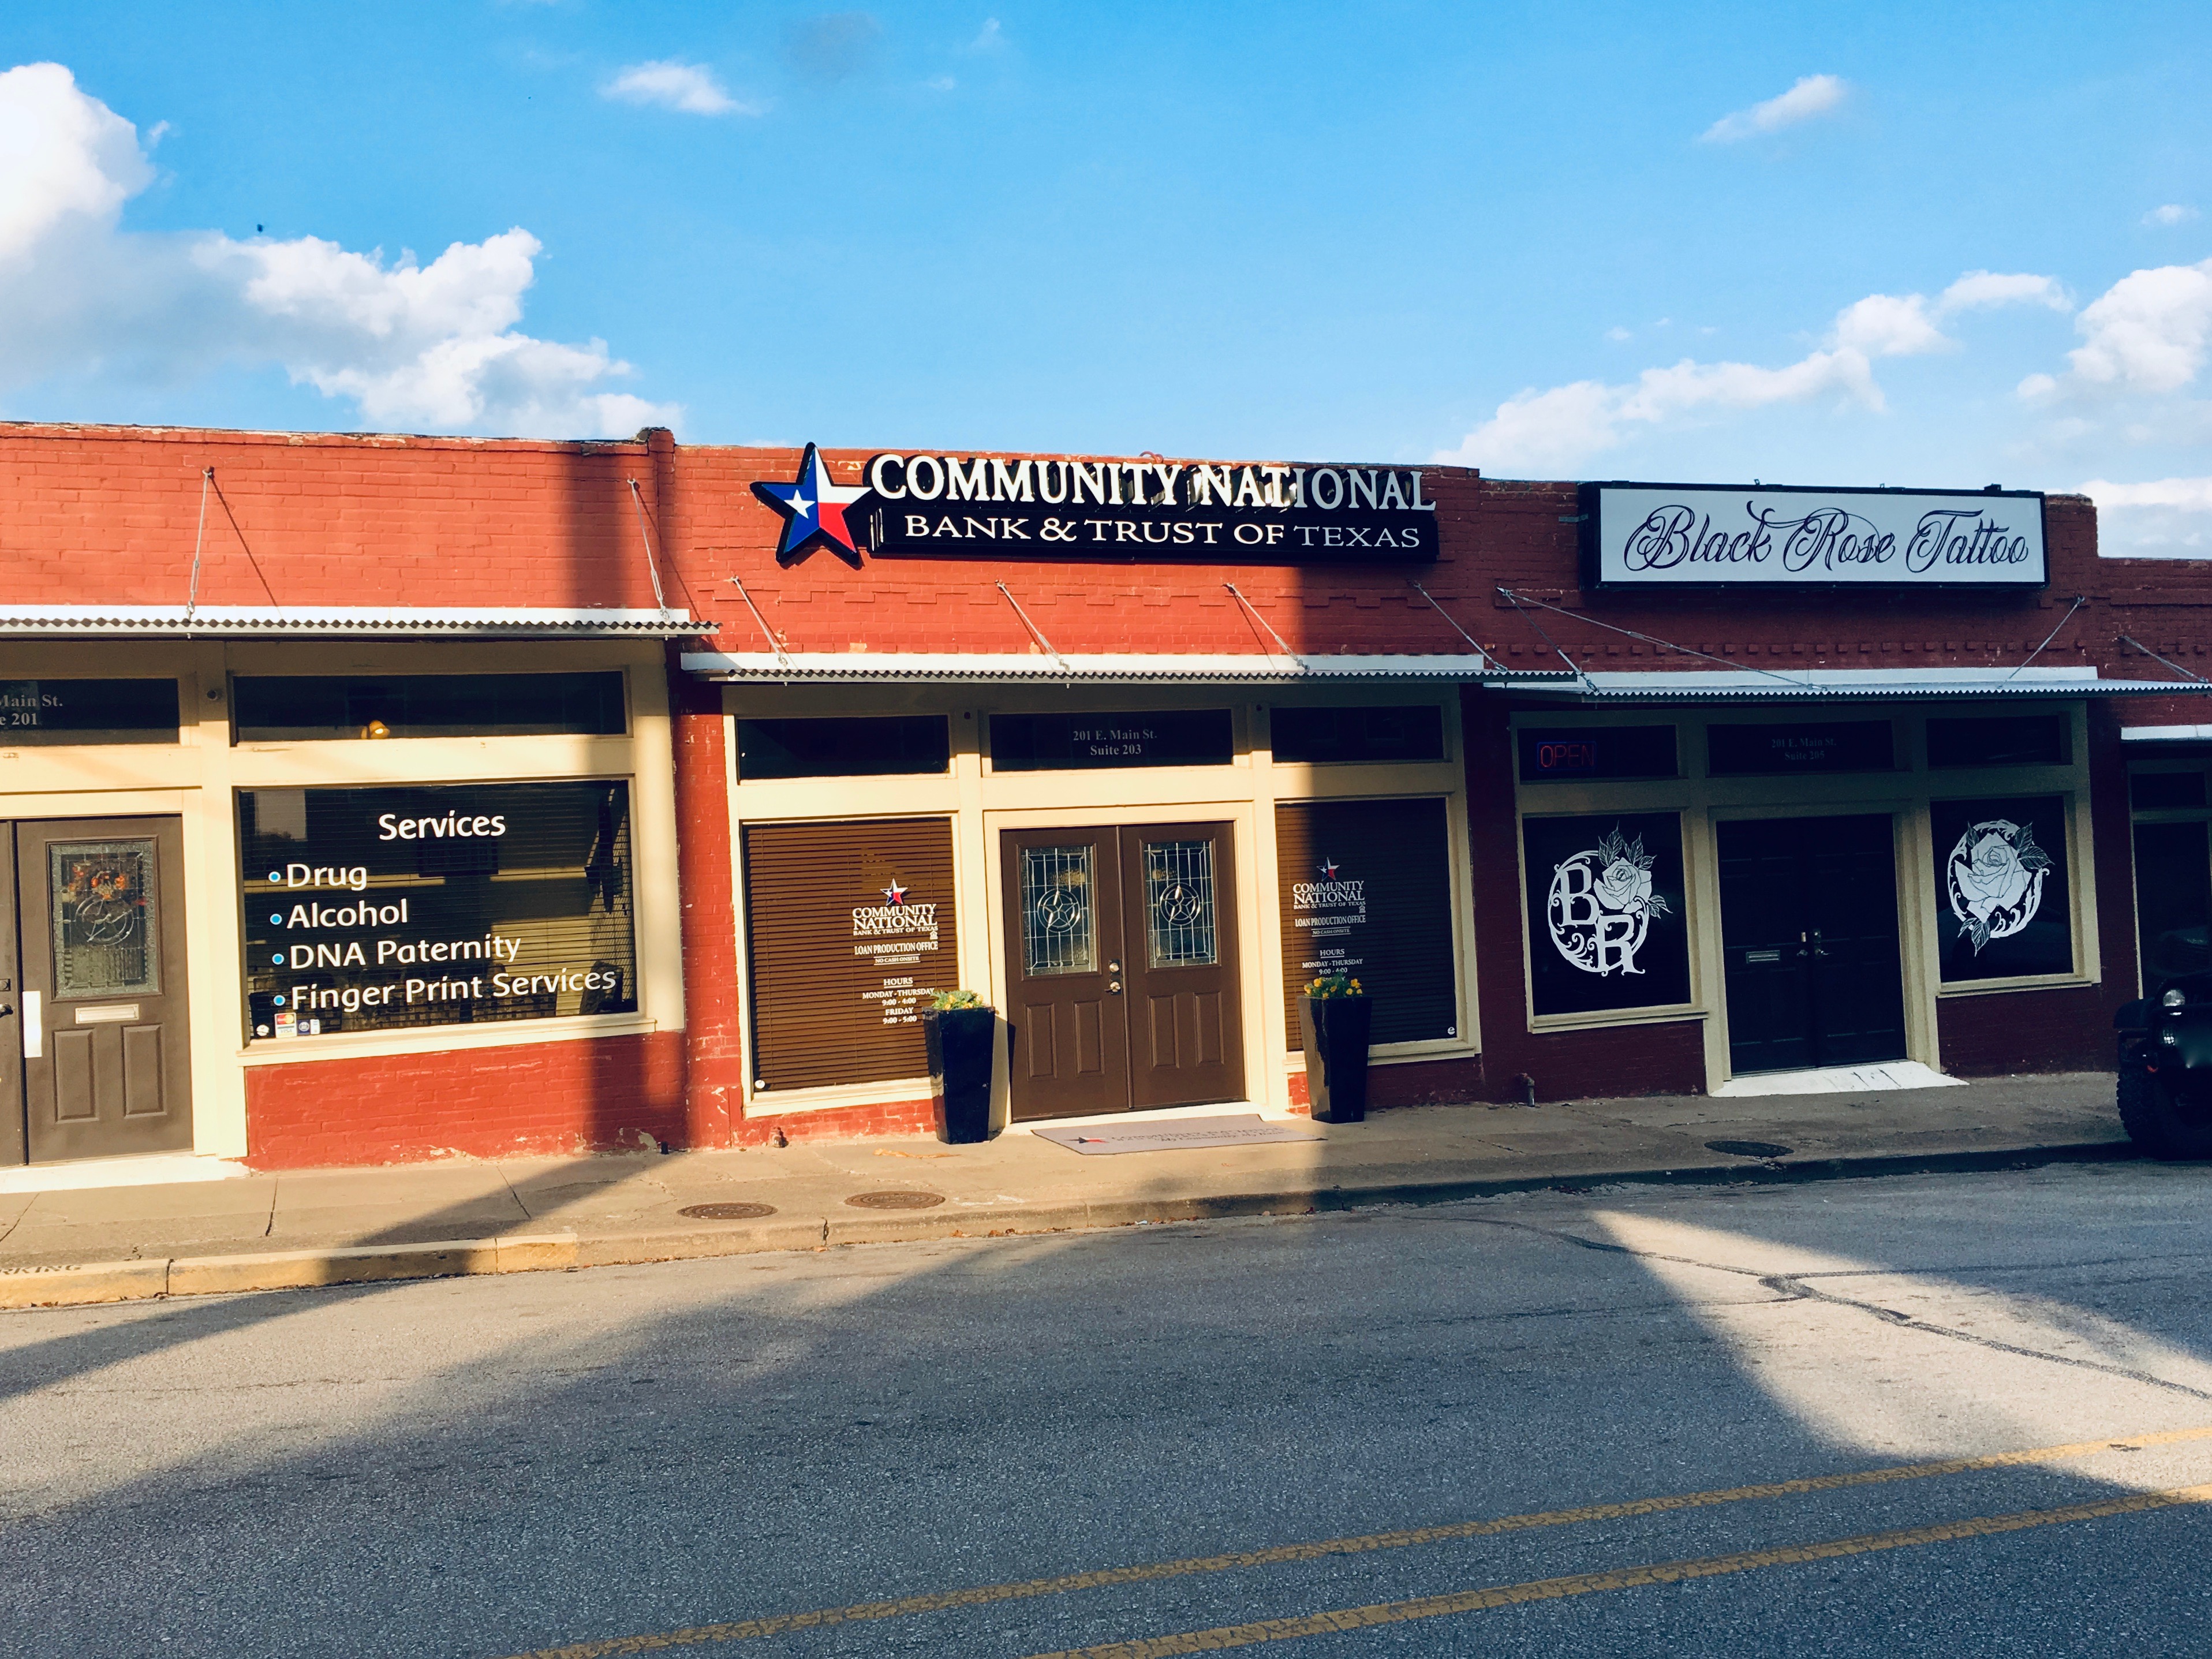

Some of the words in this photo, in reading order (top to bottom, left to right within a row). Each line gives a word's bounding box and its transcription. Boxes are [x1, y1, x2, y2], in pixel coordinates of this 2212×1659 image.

[871, 454, 1182, 506] COMMUNITY
[1200, 464, 1437, 511] NATIONAL
[905, 515, 1032, 540] BANK
[1039, 518, 1079, 542] &
[1083, 520, 1224, 544] TRUST
[1234, 524, 1285, 545] OF
[1293, 525, 1420, 548] TEXAS
[1624, 500, 1772, 571] Black
[1783, 507, 1896, 572] Rose
[1906, 509, 2030, 573] Tattoo
[42, 694, 62, 707] St.
[12, 713, 37, 725] 201
[1073, 730, 1090, 741] 201
[1096, 730, 1107, 740] E.
[1110, 730, 1139, 740] Main
[1143, 729, 1157, 739] St.
[1772, 739, 1785, 748] 201
[1800, 738, 1823, 747] Main
[1090, 745, 1120, 756] Suite
[1123, 744, 1142, 755] 203
[1541, 745, 1594, 768] OPEN
[1784, 752, 1807, 761] Suite
[379, 810, 506, 840] Services
[287, 864, 368, 891] Drug
[1293, 881, 1364, 893] COMMUNITY
[1293, 891, 1365, 904] NATIONAL
[287, 898, 408, 929] Alcohol
[852, 903, 937, 918] COMMUNITY
[853, 914, 937, 930] NATIONAL
[1295, 918, 1310, 927] LOAN
[1311, 916, 1347, 926] PRODUCTION
[1347, 915, 1366, 924] OFFICE
[290, 942, 366, 970] DNA
[378, 933, 521, 965] Paternity
[854, 945, 872, 955] LOAN
[873, 943, 916, 954] PRODUCTION
[916, 941, 939, 951] OFFICE
[1332, 958, 1363, 966] THURSDAY
[884, 977, 913, 986] HOURS
[292, 982, 395, 1012] Finger
[406, 976, 483, 1003] Print
[492, 967, 616, 997] Services
[862, 991, 894, 999] MONDAY
[897, 988, 935, 996] THURSDAY
[885, 1007, 914, 1015] FRIDAY
